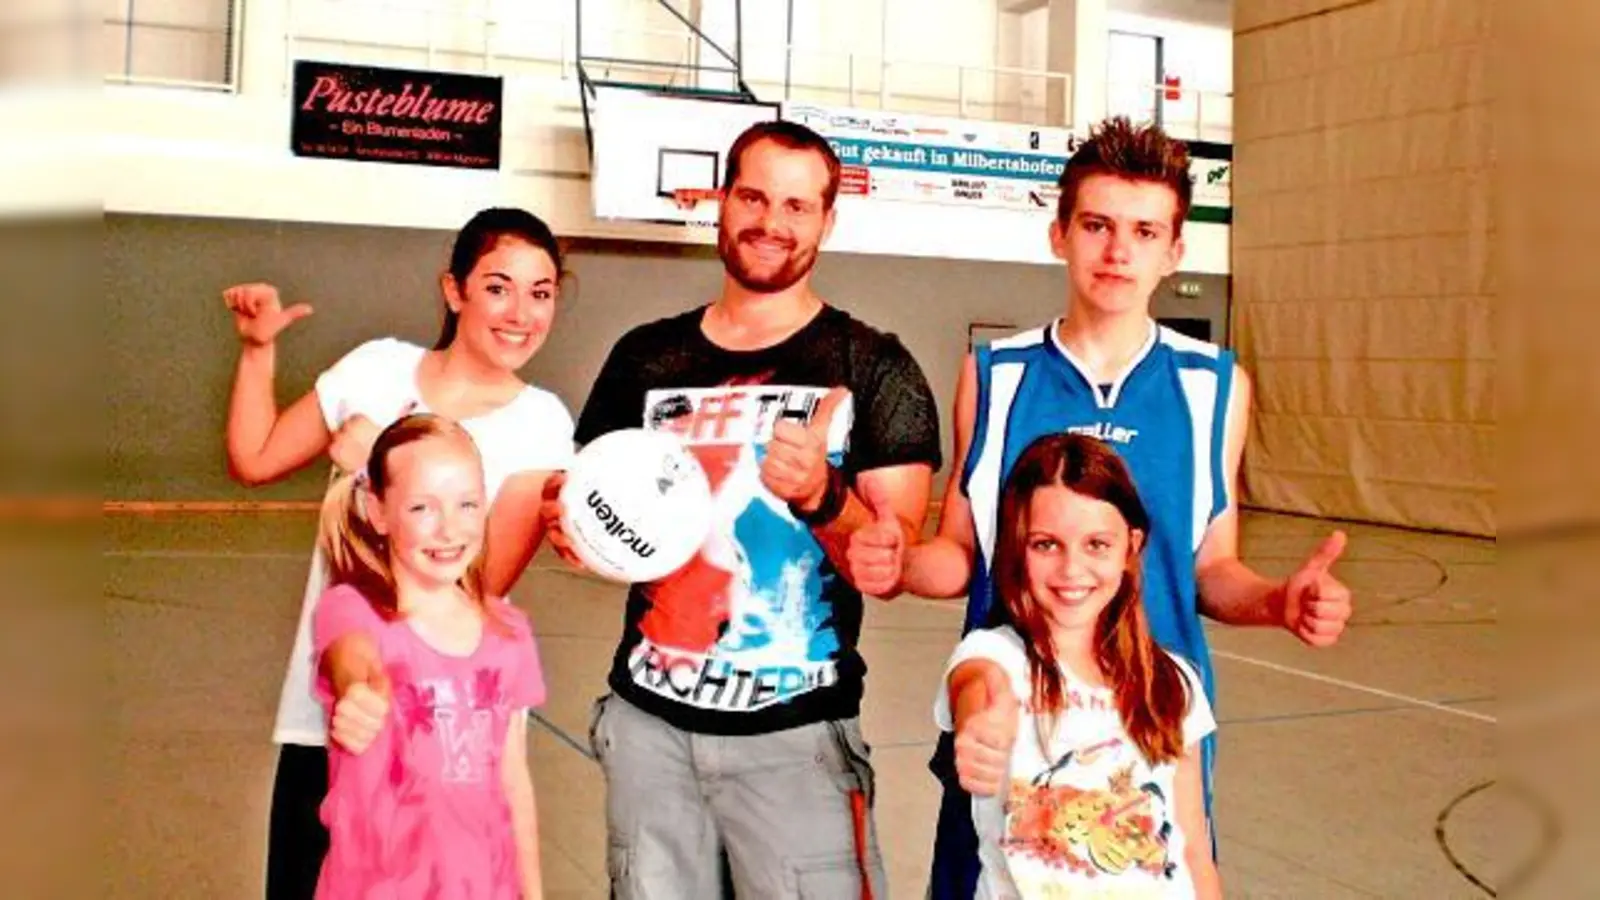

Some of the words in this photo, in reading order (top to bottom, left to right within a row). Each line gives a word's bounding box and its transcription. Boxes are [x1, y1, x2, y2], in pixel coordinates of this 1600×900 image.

[302, 75, 496, 124] Pusteblume
[341, 119, 364, 136] Ein
[366, 121, 451, 142] Blumenladen
[862, 144, 928, 165] gekauft
[930, 148, 948, 166] in
[952, 150, 1065, 176] Milbertshofen
[586, 489, 657, 558] molten
